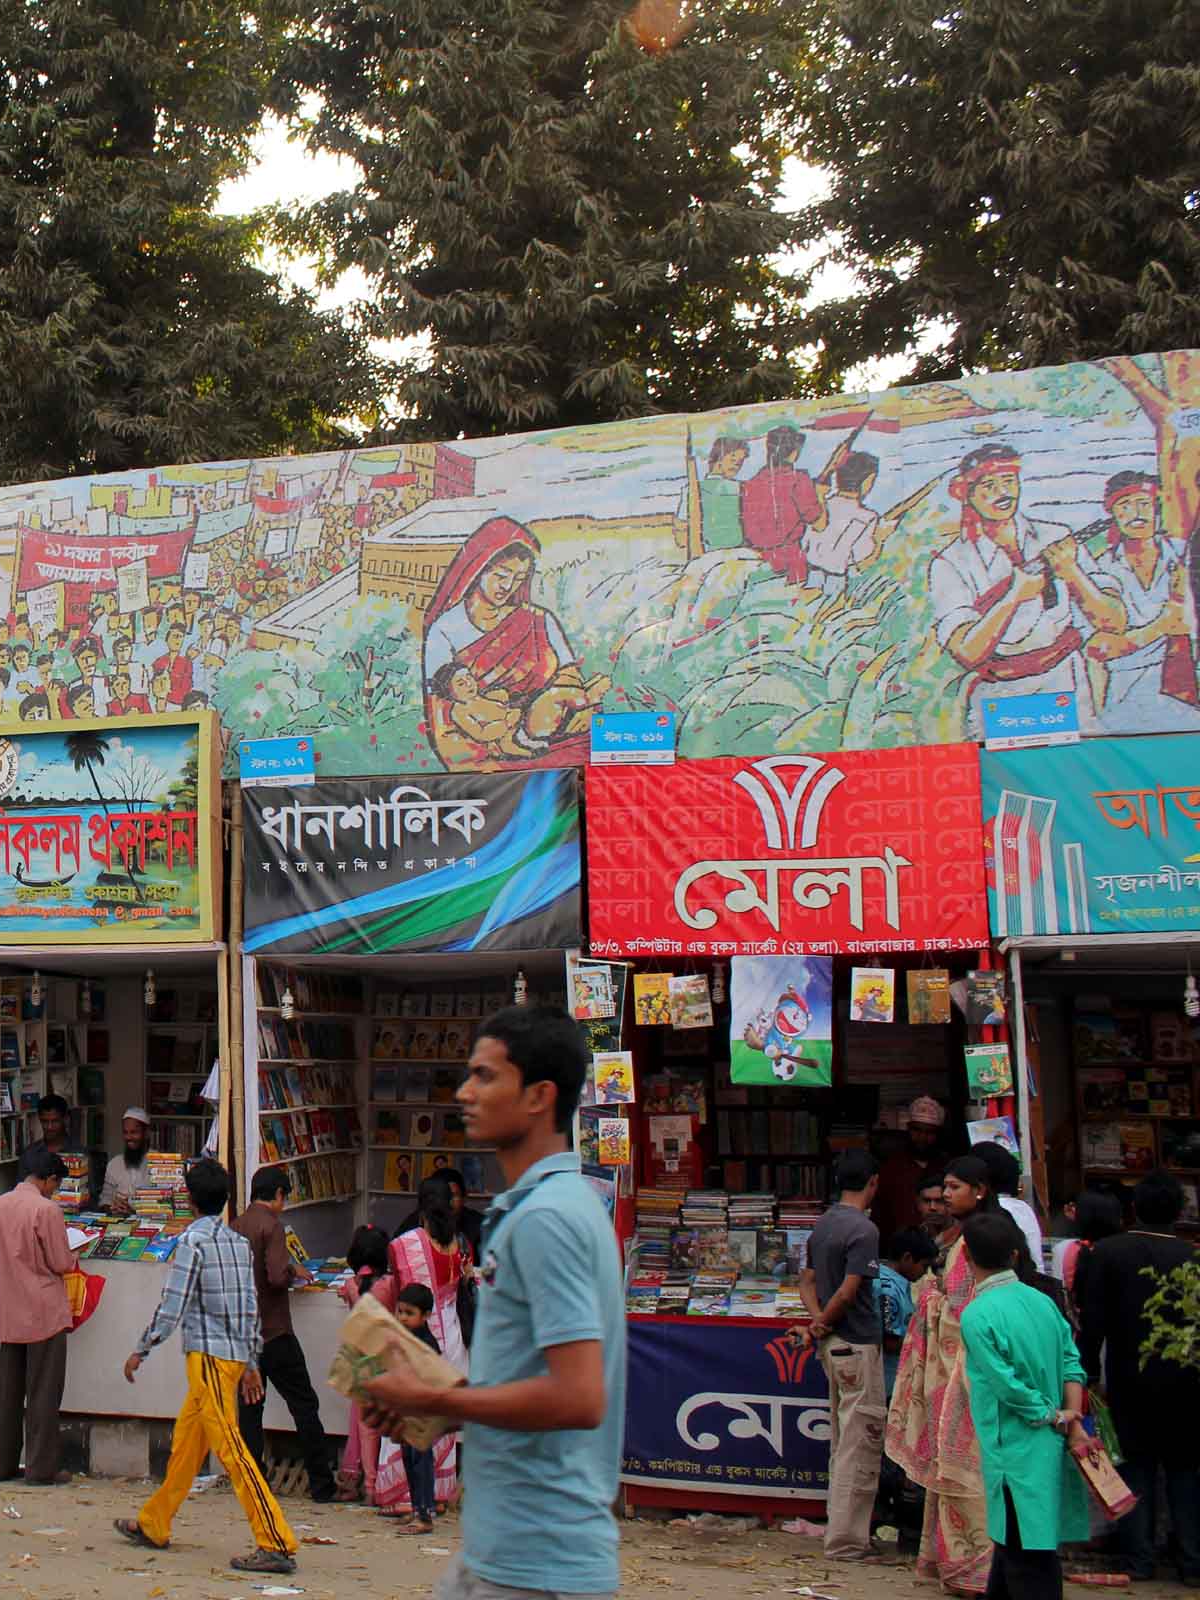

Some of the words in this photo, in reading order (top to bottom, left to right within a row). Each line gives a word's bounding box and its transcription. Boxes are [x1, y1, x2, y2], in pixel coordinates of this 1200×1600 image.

[88, 811, 198, 873] প্রকাশন
[262, 785, 489, 853] ধানশালিক
[673, 845, 914, 933] মেলা
[676, 1391, 832, 1458] মে
